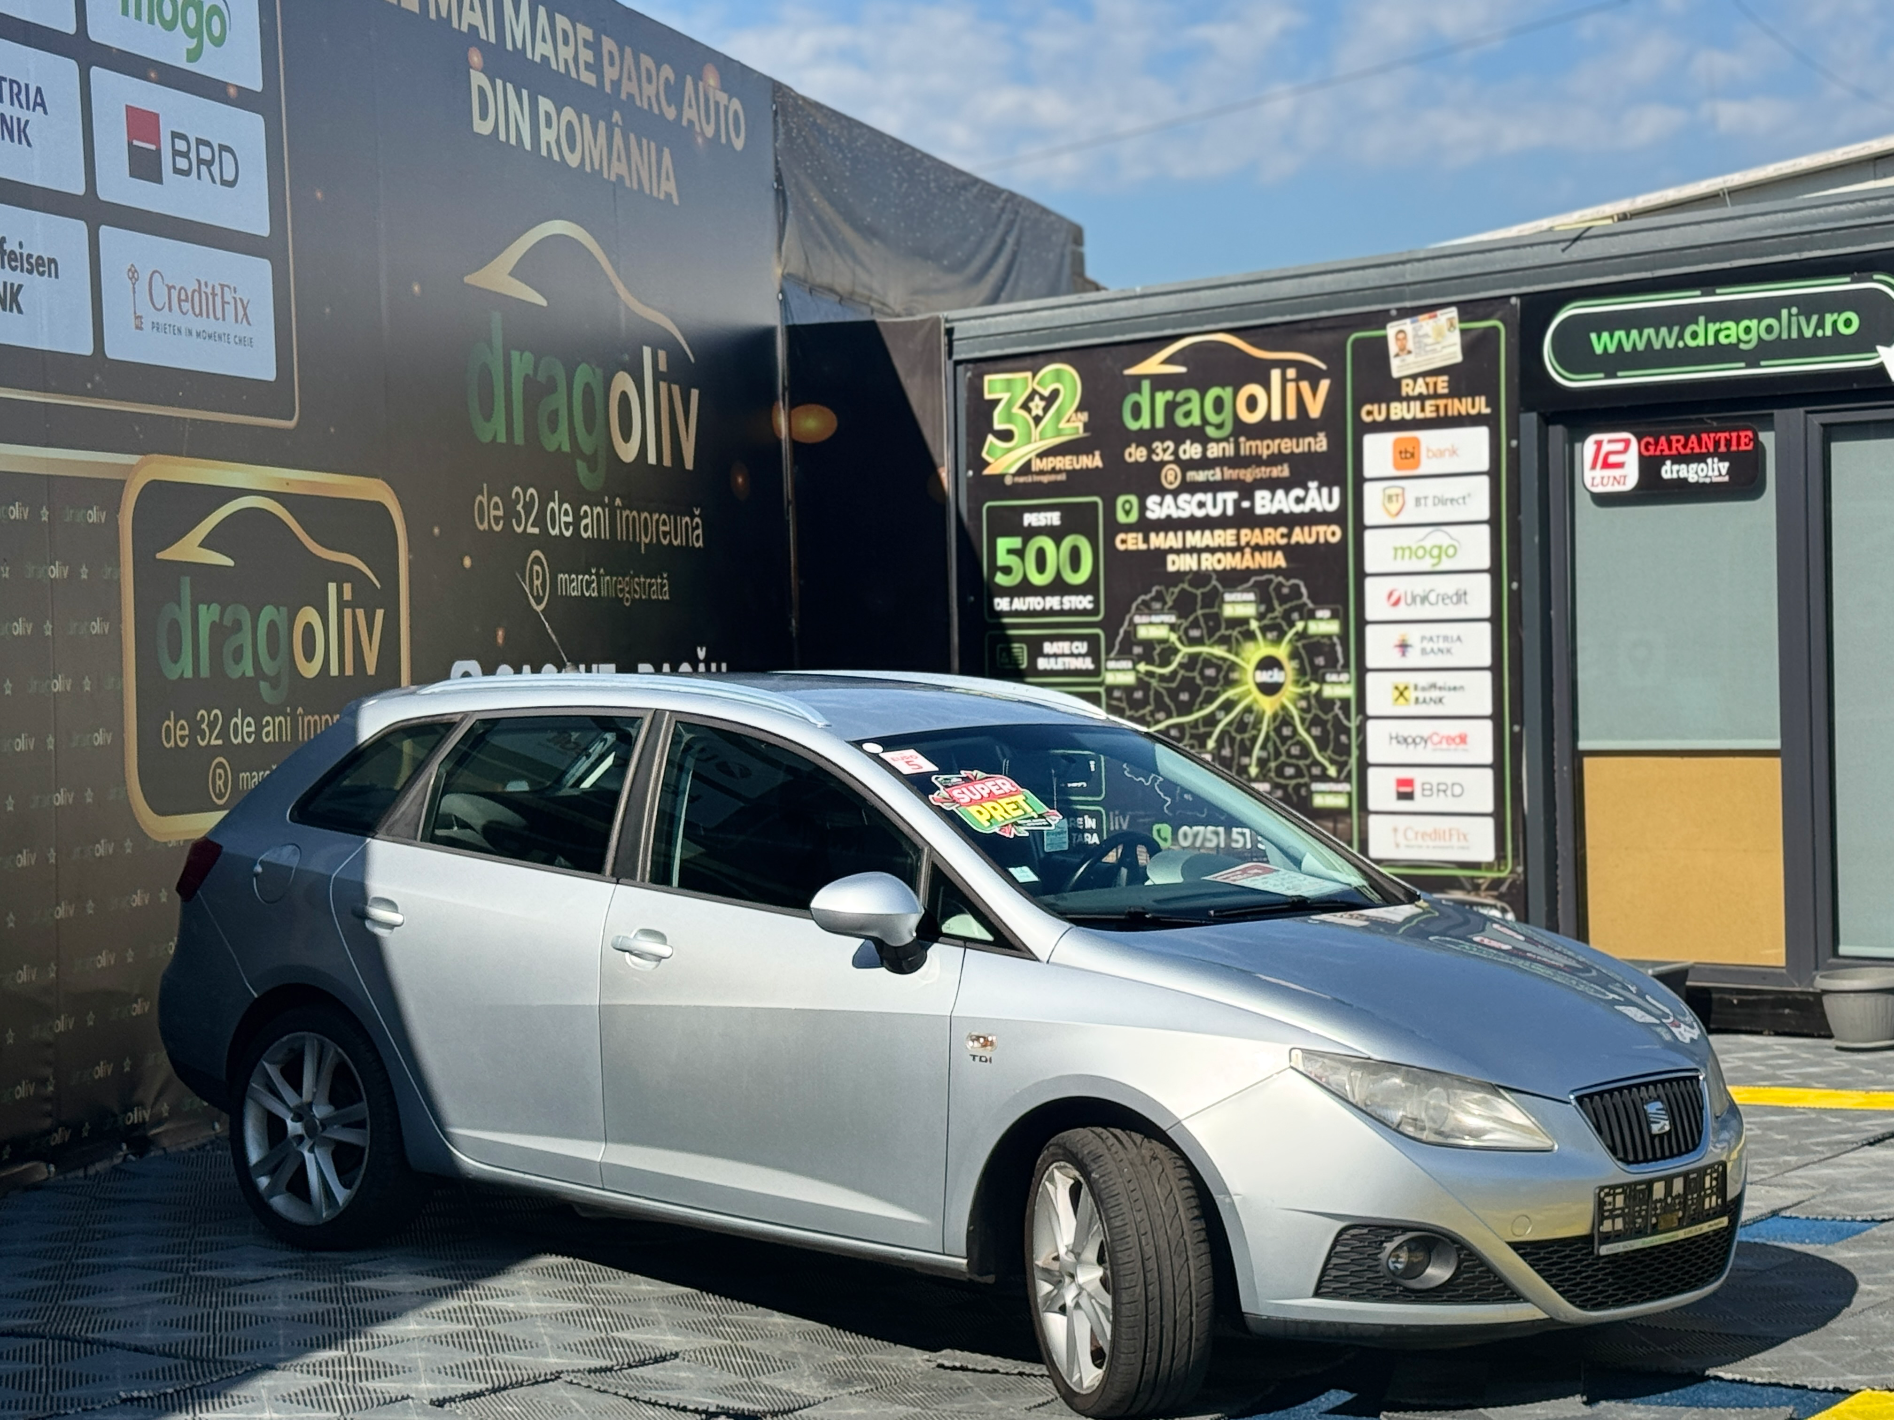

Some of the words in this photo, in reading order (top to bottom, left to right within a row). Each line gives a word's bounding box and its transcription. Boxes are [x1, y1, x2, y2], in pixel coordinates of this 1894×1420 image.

[503, 0, 597, 88] MARE
[602, 34, 677, 121] PARC
[682, 74, 746, 151] AUTO
[469, 68, 532, 151] DIN
[537, 94, 680, 206] ROMÂNIA
[170, 130, 240, 189] BRD
[147, 269, 252, 326] CreditFix
[151, 321, 182, 337] PRIETEN
[184, 326, 193, 338] IN
[195, 329, 231, 345] MOMENTE
[233, 335, 254, 348] CHEIE
[1590, 306, 1860, 355] www.dragoliv.ro
[1400, 376, 1450, 397] RATE
[466, 311, 699, 491] dragoliv
[1122, 368, 1331, 439] dragoliv
[1360, 404, 1387, 422] CU
[1389, 396, 1491, 421] BULETINUL
[1124, 443, 1148, 463] de
[1151, 440, 1175, 461] 32
[1178, 439, 1202, 460] de
[1206, 437, 1235, 458] ani
[1239, 432, 1329, 460] împreună
[1398, 447, 1416, 460] tbi
[1426, 444, 1460, 459] bank
[1590, 438, 1631, 471] 12
[1640, 430, 1754, 456] GARANTIE
[1590, 475, 1628, 488] LUNI
[1661, 457, 1730, 482] dragoliv
[1145, 491, 1239, 519] SASCUT
[1254, 481, 1340, 515] BACĂU
[1414, 496, 1430, 508] BT
[474, 483, 504, 532] de
[512, 485, 540, 535] 32
[546, 490, 573, 537] de
[579, 495, 610, 541] ani
[615, 497, 704, 554] împreună
[1023, 512, 1062, 527] PESTE
[1115, 532, 1148, 551] CEL
[1149, 531, 1183, 550] MAI
[1185, 528, 1237, 548] MARE
[1239, 527, 1288, 546] PARC
[1290, 524, 1342, 545] AUTO
[994, 534, 1094, 587] 500
[1166, 553, 1199, 572] DIN
[1201, 548, 1287, 571] ROMÂNIA
[1393, 541, 1458, 568] mogo
[557, 567, 599, 597] marcă
[600, 568, 670, 607] înregistrată
[1404, 588, 1469, 607] UniCredit
[994, 597, 1011, 612] DE
[1011, 596, 1045, 611] AUTO
[1045, 596, 1061, 610] PE
[1061, 594, 1095, 610] STOC
[157, 576, 385, 704] dragoliv
[1043, 641, 1071, 655] RATE
[1071, 641, 1088, 655] CU
[1420, 635, 1463, 645] PATRIA
[1420, 647, 1453, 656] BANK
[1037, 657, 1095, 670] BULETINUL
[1414, 696, 1446, 706] BANK
[162, 711, 189, 748] de
[197, 709, 223, 746] 32
[230, 708, 256, 745] de
[262, 707, 291, 743] ani
[1389, 732, 1468, 750] HappyCredit
[239, 764, 278, 790] mar
[904, 760, 923, 770] 5
[951, 779, 1018, 804] SUPER
[1421, 782, 1465, 798] BRD
[1177, 825, 1225, 848] 0751
[1231, 827, 1252, 849] 51
[1403, 826, 1469, 843] CreditFix
[969, 1054, 992, 1064] TDI
